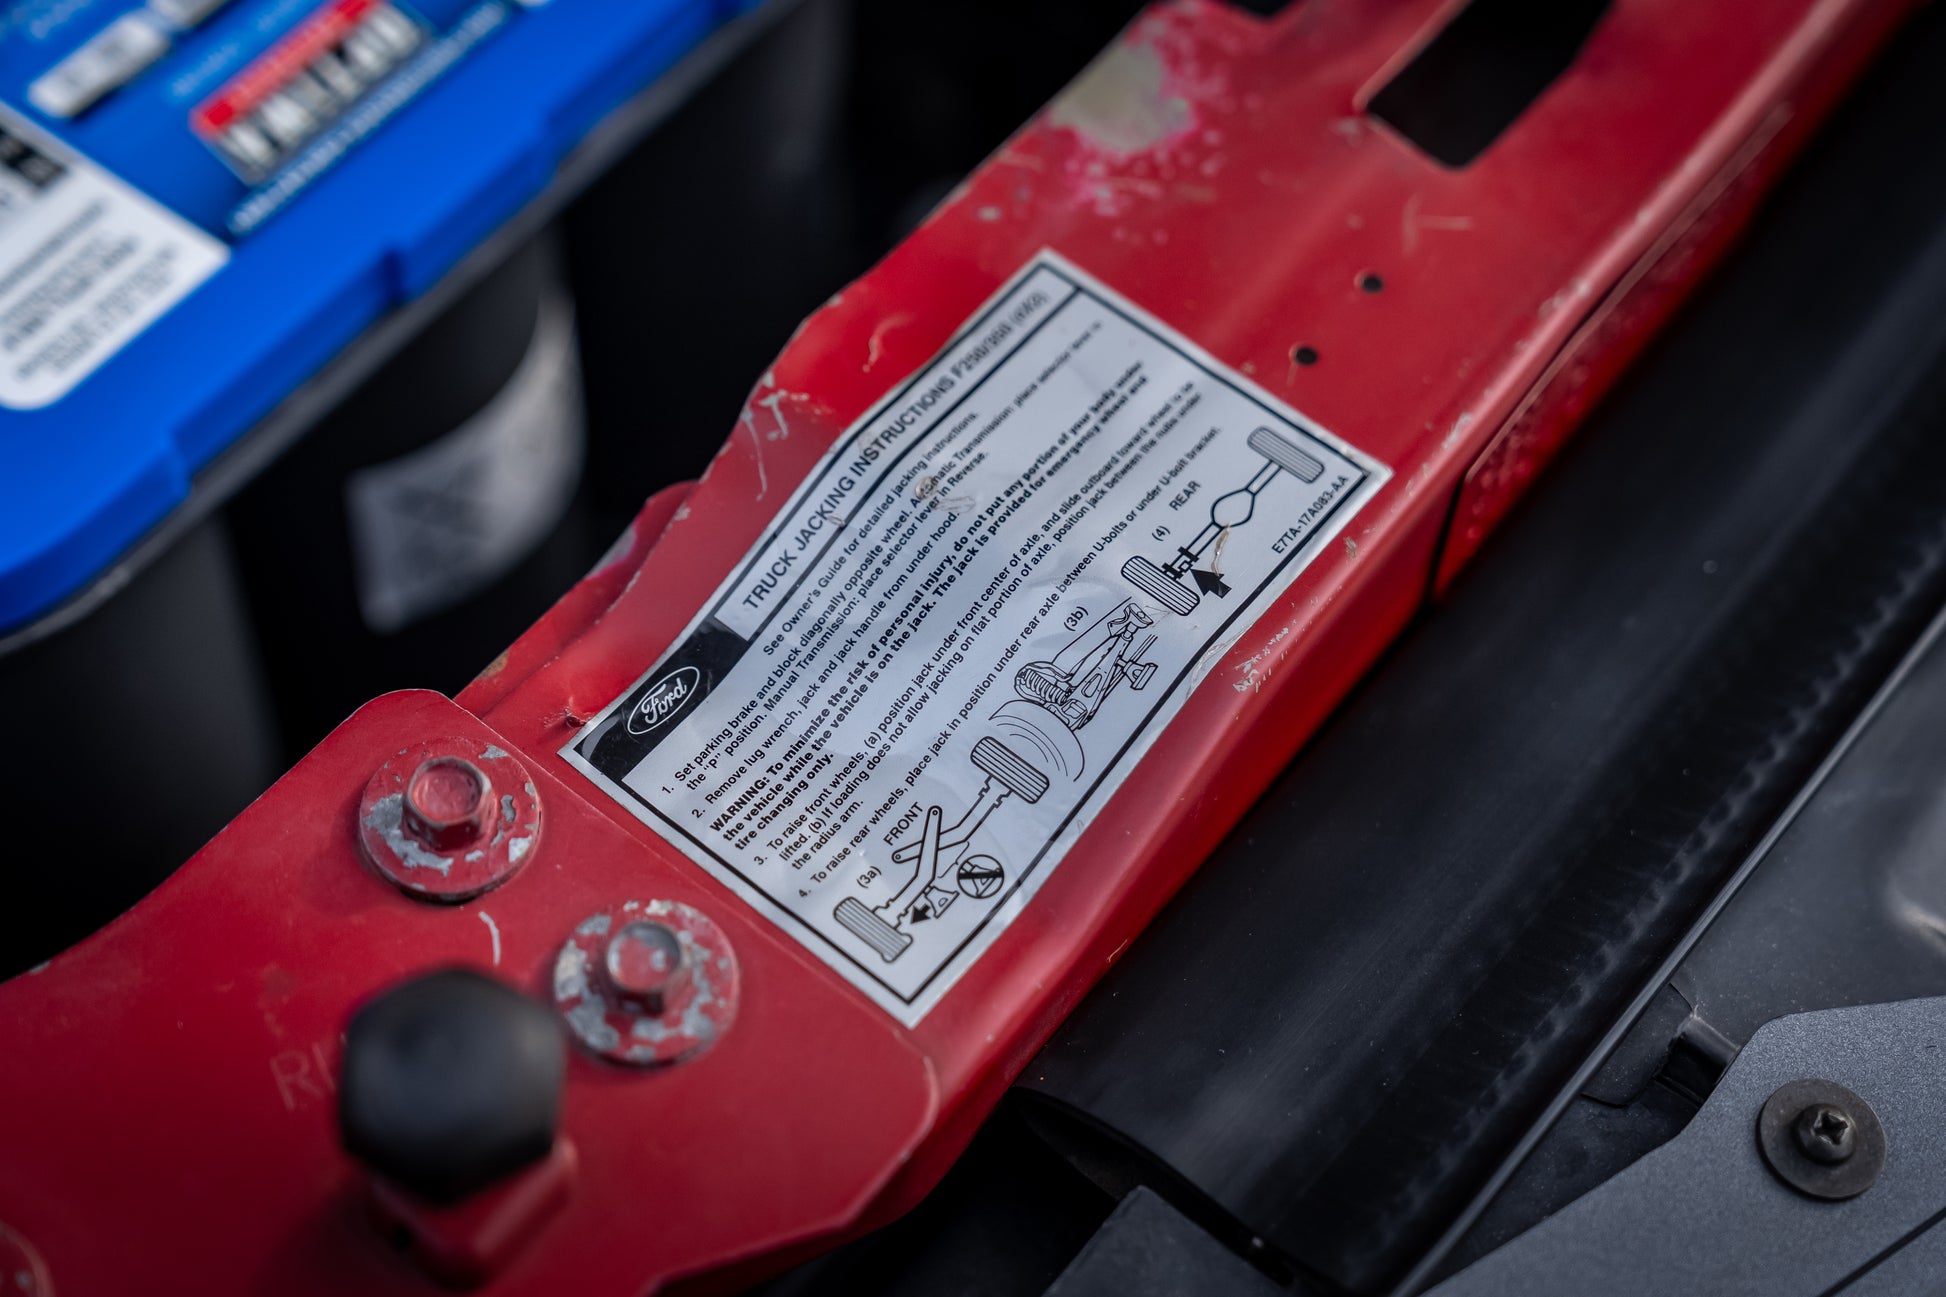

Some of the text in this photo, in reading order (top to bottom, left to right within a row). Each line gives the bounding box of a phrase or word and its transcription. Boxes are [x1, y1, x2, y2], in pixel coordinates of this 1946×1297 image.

[661, 785, 675, 794] 1.
[674, 762, 697, 782] Set
[693, 727, 734, 767] parking
[727, 699, 759, 730] brake
[756, 675, 777, 700] and
[771, 646, 803, 679] block
[799, 590, 847, 648] diagonally
[843, 544, 884, 592] opposite
[880, 509, 913, 544] wheel.
[951, 406, 1014, 462] Transmission:
[742, 549, 798, 609] TRUCK
[794, 475, 856, 552] JACKING
[849, 377, 955, 477] INSTRUCTIONS
[762, 413, 979, 656] See Owner's Guide for detailed jacking instructions.
[1151, 525, 1171, 542] (4)
[1168, 480, 1201, 511] REAR
[1271, 475, 1349, 555] E7TA-17A083-AA
[641, 676, 688, 724] Ford
[686, 773, 707, 791] the
[722, 714, 768, 757] position.
[762, 669, 801, 712] Manual
[795, 596, 861, 670] Transmission:
[857, 566, 884, 599] place
[881, 522, 919, 568] selector
[914, 495, 941, 524] lever
[936, 486, 951, 498] in
[946, 452, 988, 487] Reverse.
[691, 511, 960, 819] 2. Remove lug wrench, jack and jack handle from under hood.
[709, 776, 771, 832] WARNING:
[765, 761, 784, 776] To
[782, 708, 831, 763] minimize
[827, 685, 849, 708] the
[846, 659, 870, 686] risk
[867, 642, 881, 660] of
[878, 589, 925, 647] personal
[919, 554, 957, 592] injury,
[953, 535, 969, 553] do
[966, 514, 988, 536] not
[984, 495, 1006, 518] put
[1002, 478, 1025, 499] any
[1021, 444, 1060, 482] portion
[1057, 432, 1070, 447] of
[1067, 411, 1092, 437] your
[1087, 387, 1119, 415] body
[722, 822, 745, 842] the
[742, 783, 785, 822] vehicle
[782, 751, 815, 783] while
[810, 729, 833, 752] the
[829, 683, 869, 729] vehicle
[863, 670, 880, 684] is
[877, 652, 894, 670] on
[889, 630, 911, 652] the
[906, 600, 937, 633] jack.
[931, 574, 957, 598] The
[951, 546, 980, 577] jack
[974, 533, 990, 547] is
[986, 488, 1033, 536] provided
[1028, 475, 1047, 492] for
[1045, 422, 1103, 478] emergency
[753, 855, 768, 866] 3.
[766, 837, 784, 850] To
[781, 814, 808, 839] raise
[804, 787, 833, 815] front
[828, 751, 869, 789] wheels,
[863, 731, 882, 750] (a)
[877, 686, 917, 735] position
[910, 661, 936, 690] jack
[931, 628, 960, 663] under
[956, 601, 984, 630] front
[980, 566, 1011, 602] center
[1008, 552, 1022, 568] of
[1019, 533, 1046, 556] axle,
[1040, 511, 1062, 533] and
[1058, 493, 1083, 516] slide
[1079, 453, 1121, 495] outboard
[1115, 426, 1150, 459] toward
[778, 832, 812, 862] lifted.
[807, 817, 827, 834] (b)
[820, 806, 834, 819] If
[829, 770, 871, 810] loading
[866, 742, 892, 771] does
[887, 721, 908, 744] not
[904, 691, 931, 724] allow
[925, 651, 964, 696] jacking
[959, 635, 976, 652] on
[970, 615, 991, 636] flat
[987, 577, 1023, 619] portion
[1020, 562, 1033, 578] of
[1030, 543, 1057, 566] axle,
[1052, 505, 1091, 543] position
[1084, 487, 1109, 509] jack
[1103, 452, 1145, 490] between
[1138, 437, 1159, 455] the
[798, 426, 1222, 898] 4. To raise rear wheels, place jack in position under rear axle between U-bolts or under U-bolt bracket.
[1063, 605, 1089, 632] (3b)
[734, 752, 834, 851] tire changing only.
[791, 800, 864, 870] the radius arm.
[856, 865, 882, 889] (3a)
[882, 801, 924, 847] FRONT
